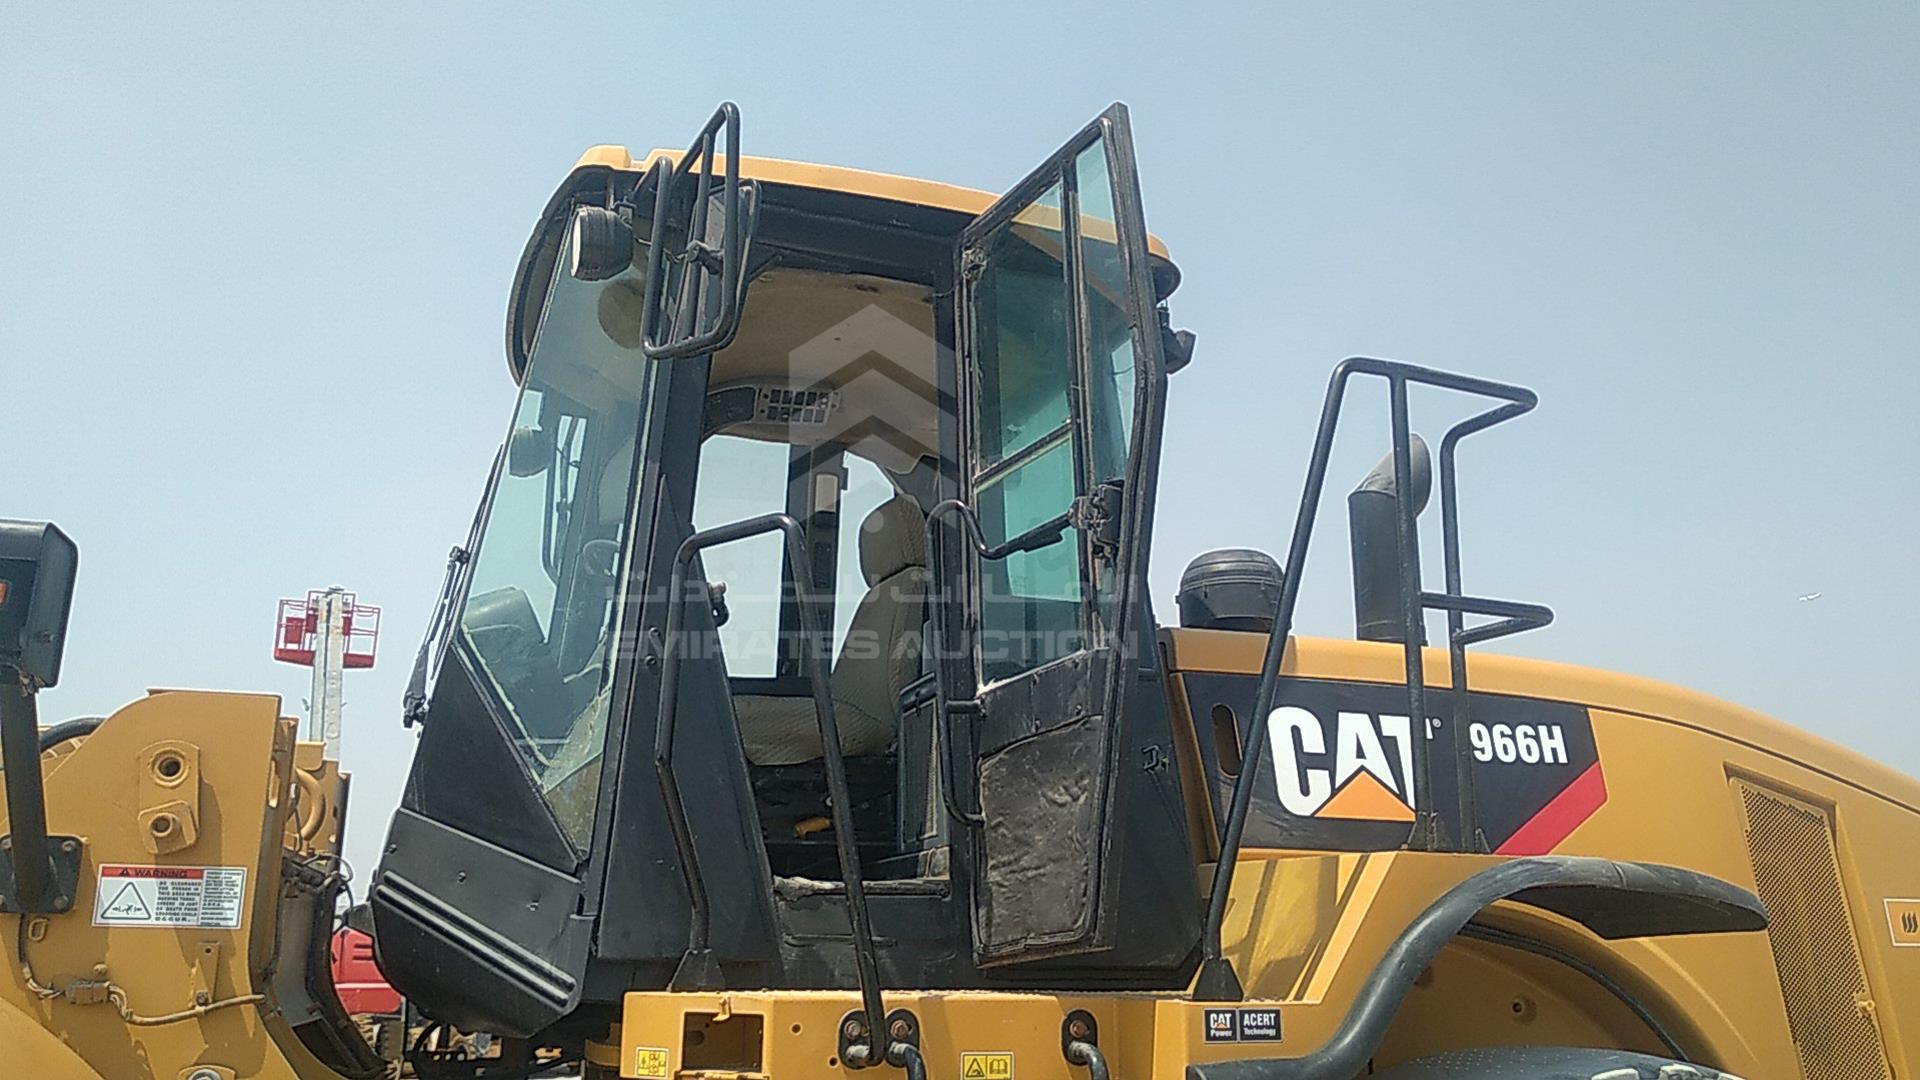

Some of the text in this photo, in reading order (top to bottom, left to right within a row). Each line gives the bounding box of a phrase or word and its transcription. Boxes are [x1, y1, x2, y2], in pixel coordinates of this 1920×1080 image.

[1469, 722, 1568, 764] 966H
[1267, 706, 1433, 816] CAT
[135, 867, 188, 879] WARNING
[1210, 1013, 1232, 1028] CAT
[1243, 1013, 1276, 1026] ACERT
[1210, 1029, 1232, 1037] Power
[1243, 1027, 1276, 1036] Technology
